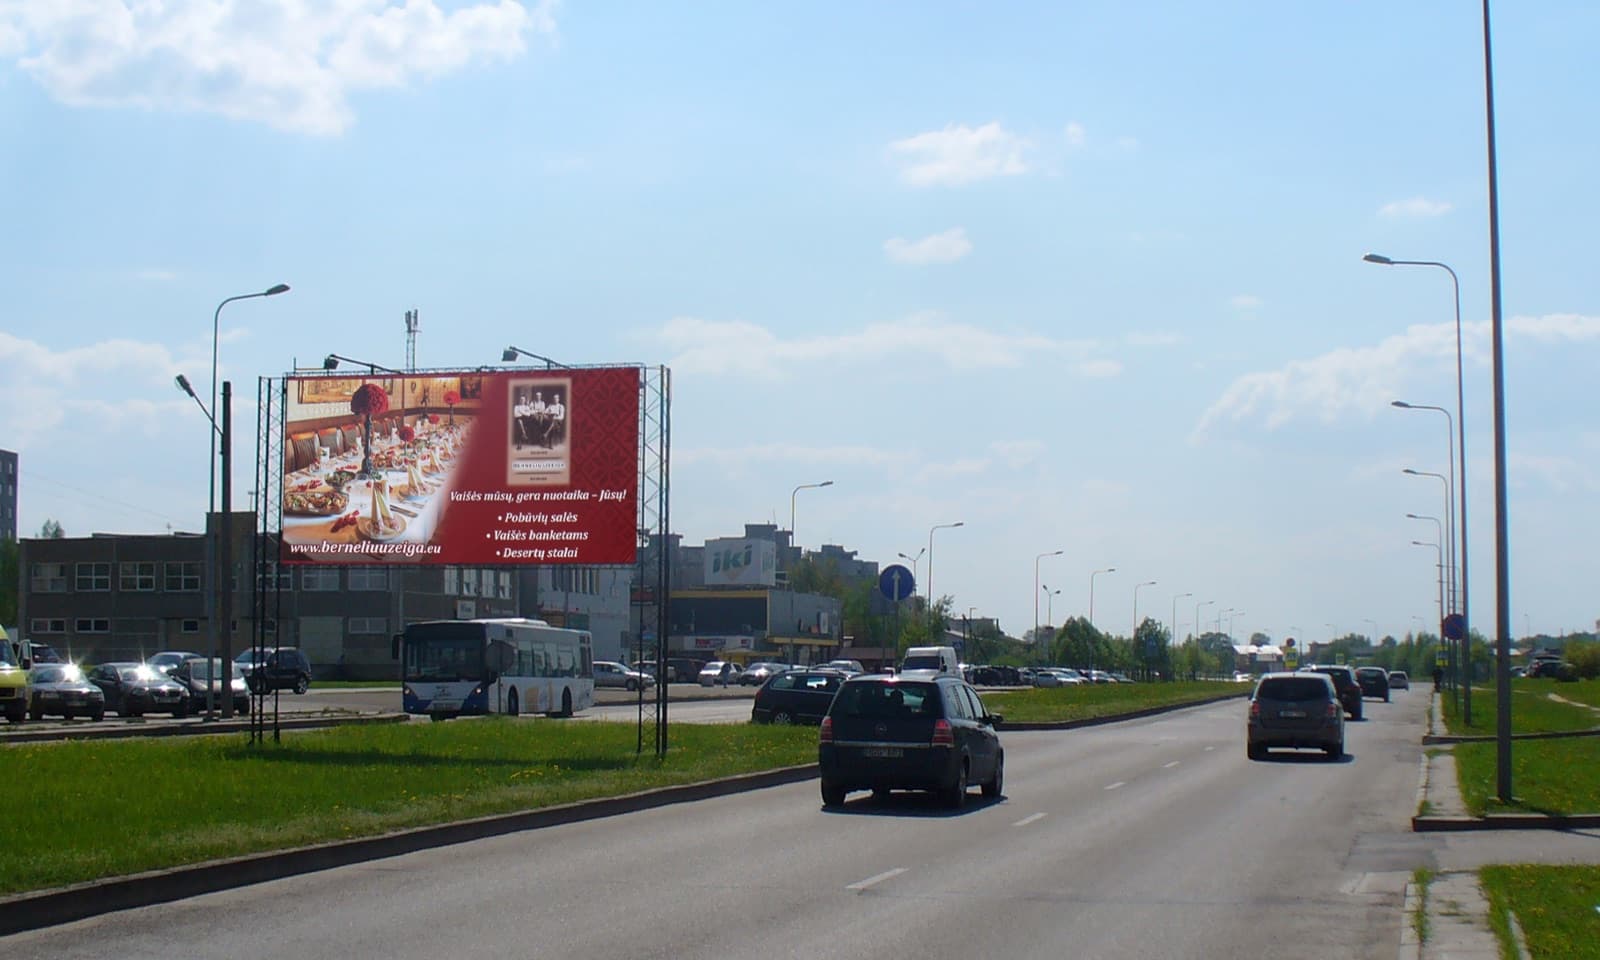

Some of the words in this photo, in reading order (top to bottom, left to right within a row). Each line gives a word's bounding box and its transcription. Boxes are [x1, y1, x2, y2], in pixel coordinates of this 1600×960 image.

[450, 491, 482, 501] Vaišės
[516, 492, 541, 503] gera
[543, 490, 589, 500] nuotaika
[504, 512, 549, 525] Pobūvių
[550, 512, 578, 523] salės
[494, 530, 527, 541] Vaišės
[528, 530, 588, 541] banketams
[290, 541, 441, 557] www.berneliuuzeiga.eu
[503, 548, 545, 560] Desertų
[546, 547, 578, 558] stalai
[713, 544, 753, 573] iki
